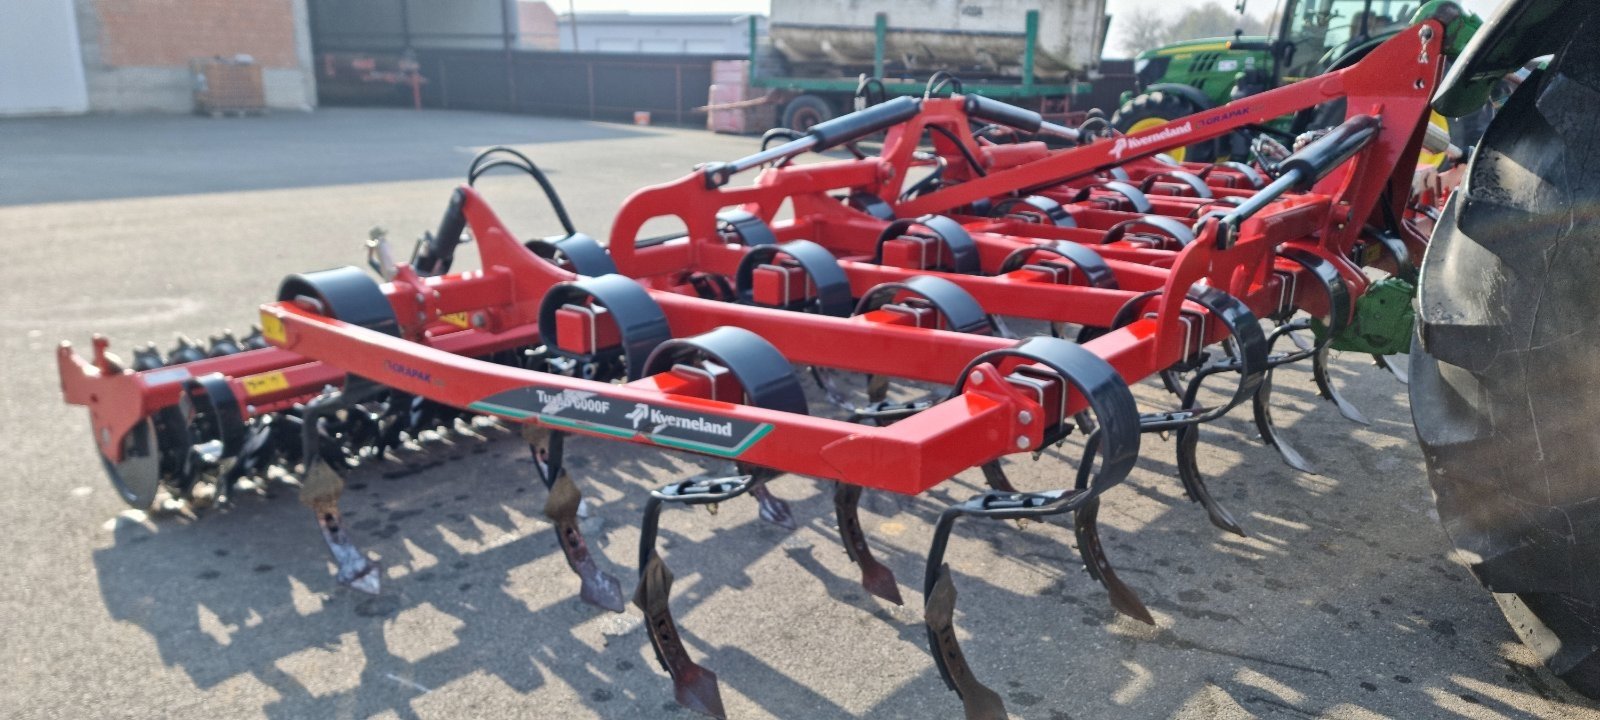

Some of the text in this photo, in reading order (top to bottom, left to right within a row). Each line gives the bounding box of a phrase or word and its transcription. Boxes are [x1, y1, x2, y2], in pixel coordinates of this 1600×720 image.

[1128, 121, 1192, 149] Kverneland
[573, 398, 610, 414] 6000F
[651, 409, 732, 437] Kverneland
